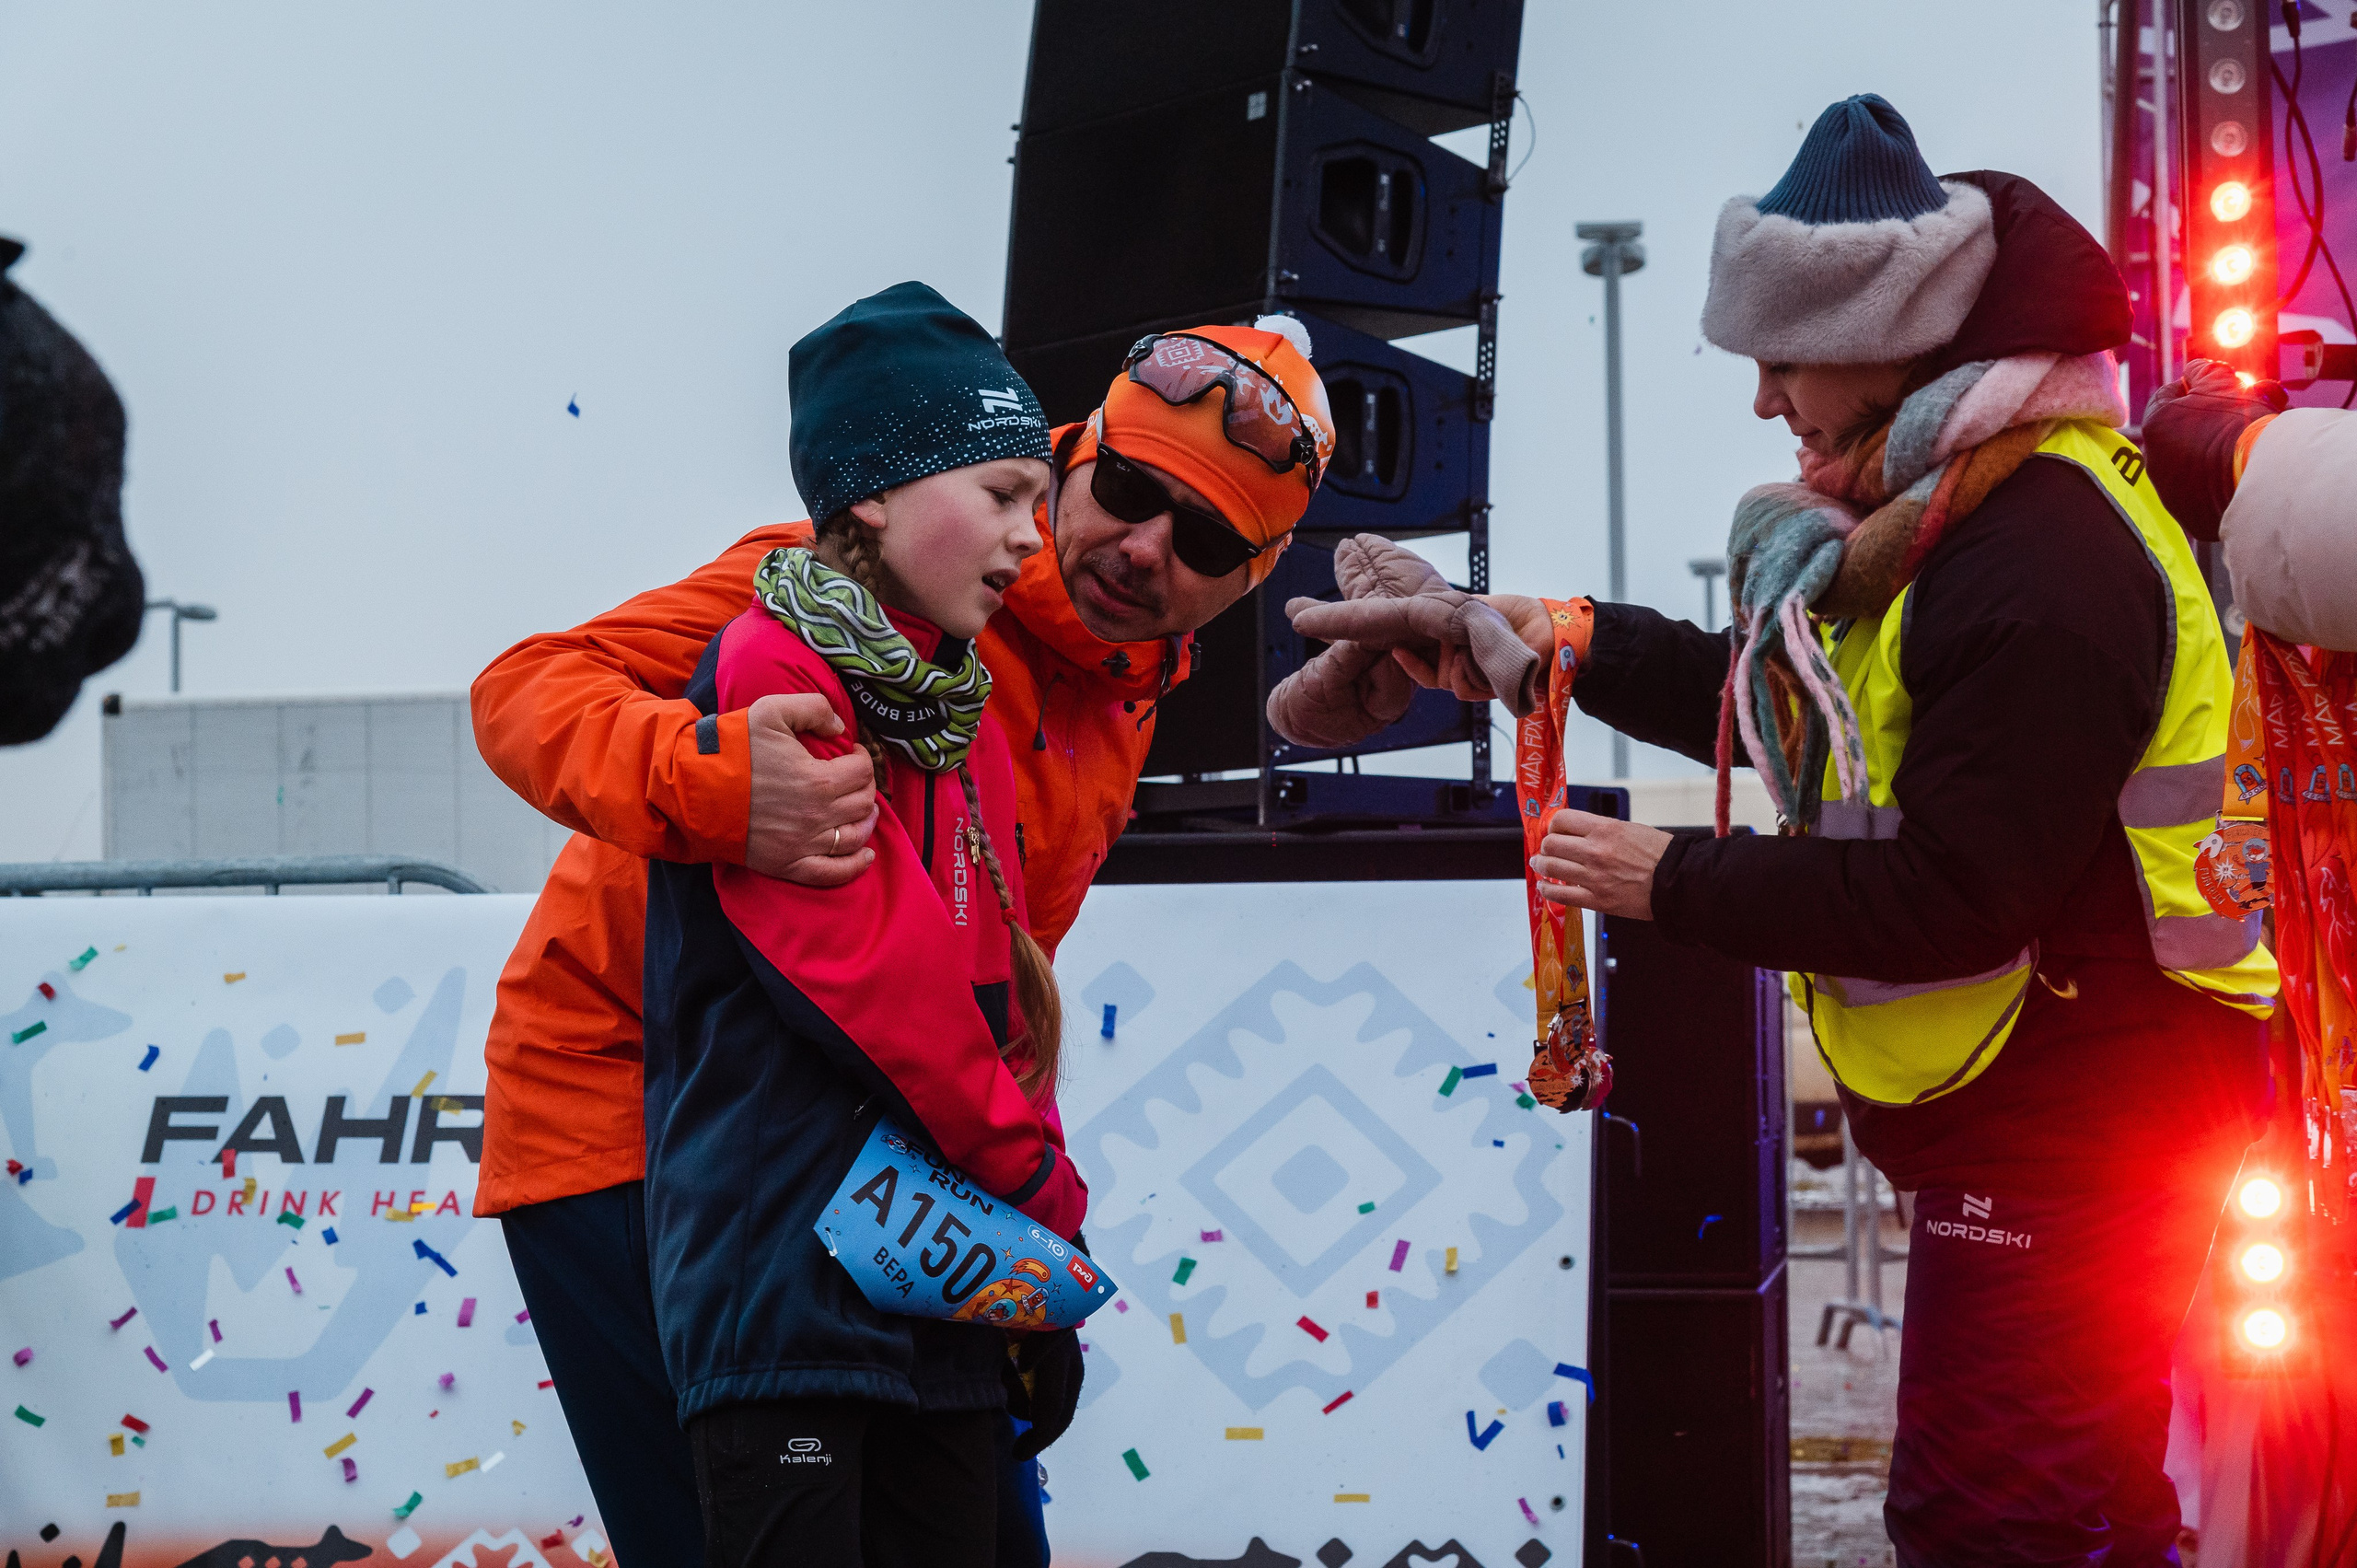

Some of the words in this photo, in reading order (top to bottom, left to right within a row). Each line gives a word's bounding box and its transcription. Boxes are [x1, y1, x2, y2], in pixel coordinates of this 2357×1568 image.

[968, 416, 1041, 432] NORDSKI
[851, 680, 900, 721] BRIDE
[953, 817, 968, 926] NORDSKI
[140, 1096, 486, 1164] FAHR
[906, 1141, 966, 1186] FUN
[191, 1190, 342, 1216] DRINK
[928, 1168, 994, 1216] RUN
[849, 1165, 997, 1305] A150
[1926, 1219, 2032, 1249] NORDSKI
[873, 1246, 915, 1299] ВЕРА
[779, 1453, 832, 1466] Kalenji
